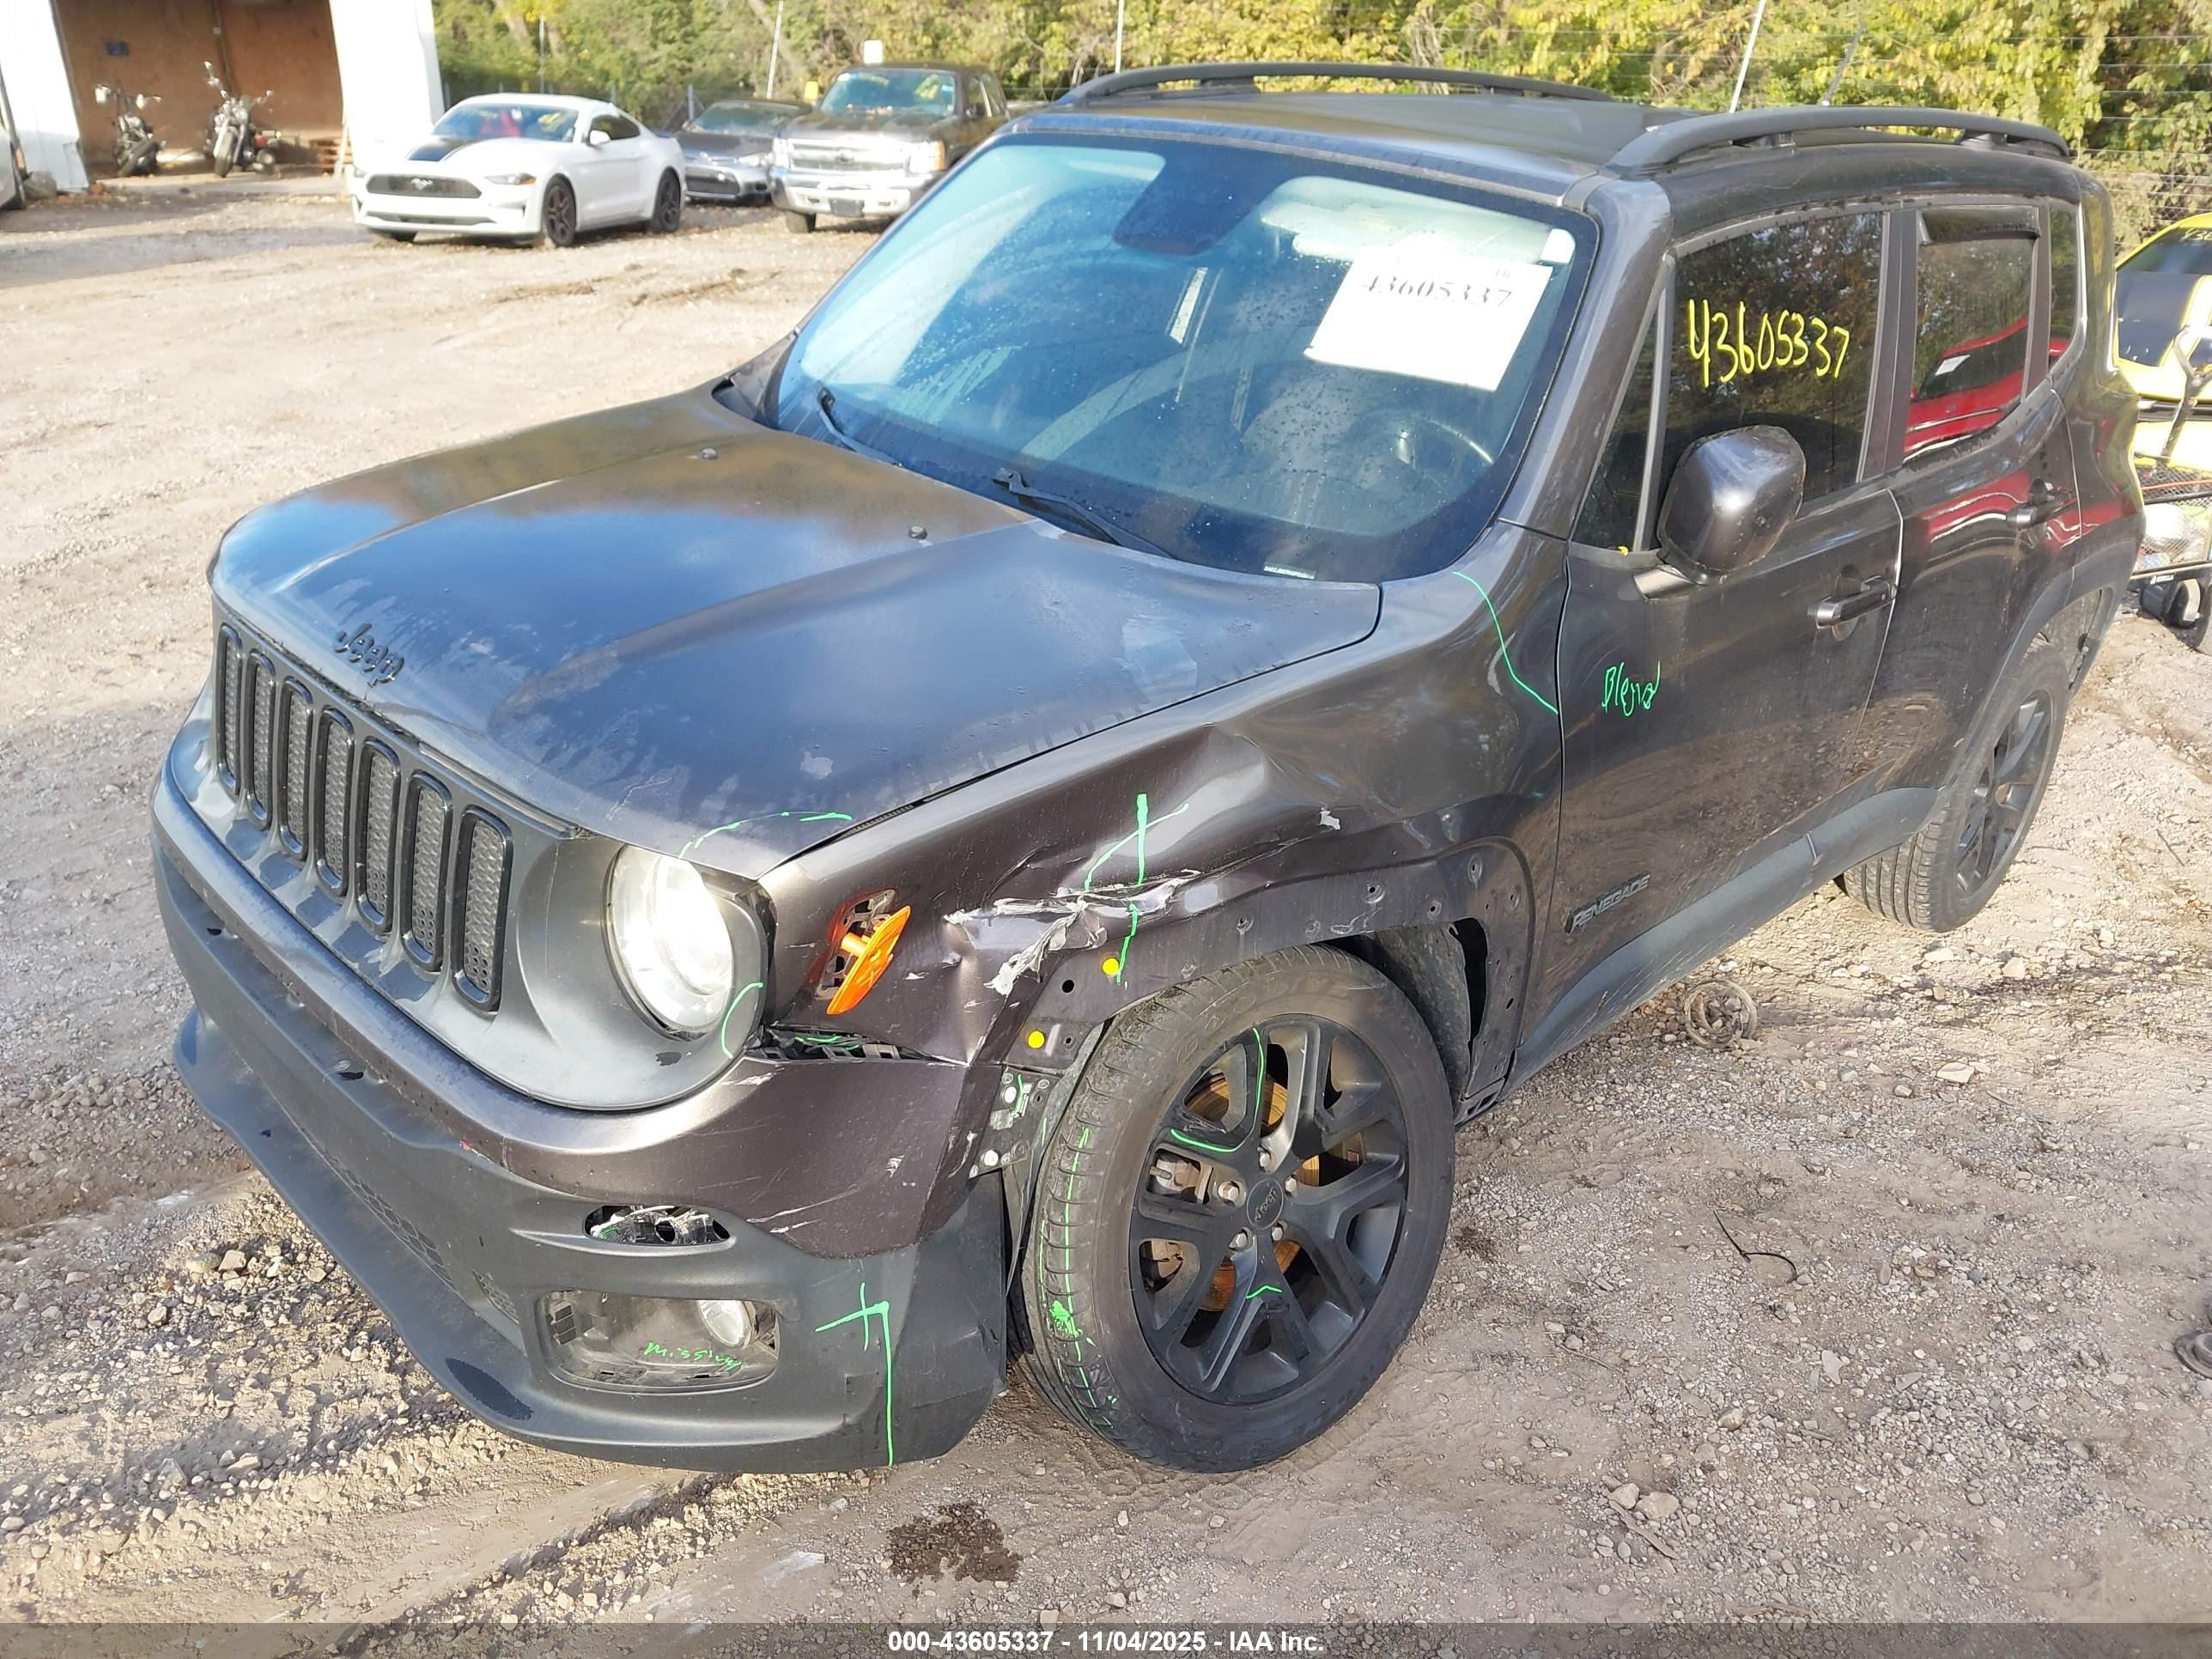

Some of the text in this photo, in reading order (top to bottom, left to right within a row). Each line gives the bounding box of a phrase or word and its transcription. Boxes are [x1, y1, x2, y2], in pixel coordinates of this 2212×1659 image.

[1362, 275, 1514, 308] 43605337
[1688, 298, 1850, 387] 43605337
[334, 623, 405, 688] Jeep
[1601, 659, 1662, 717] Blend
[1570, 872, 1651, 933] RENEGADE
[1254, 1187, 1278, 1221] Jeep
